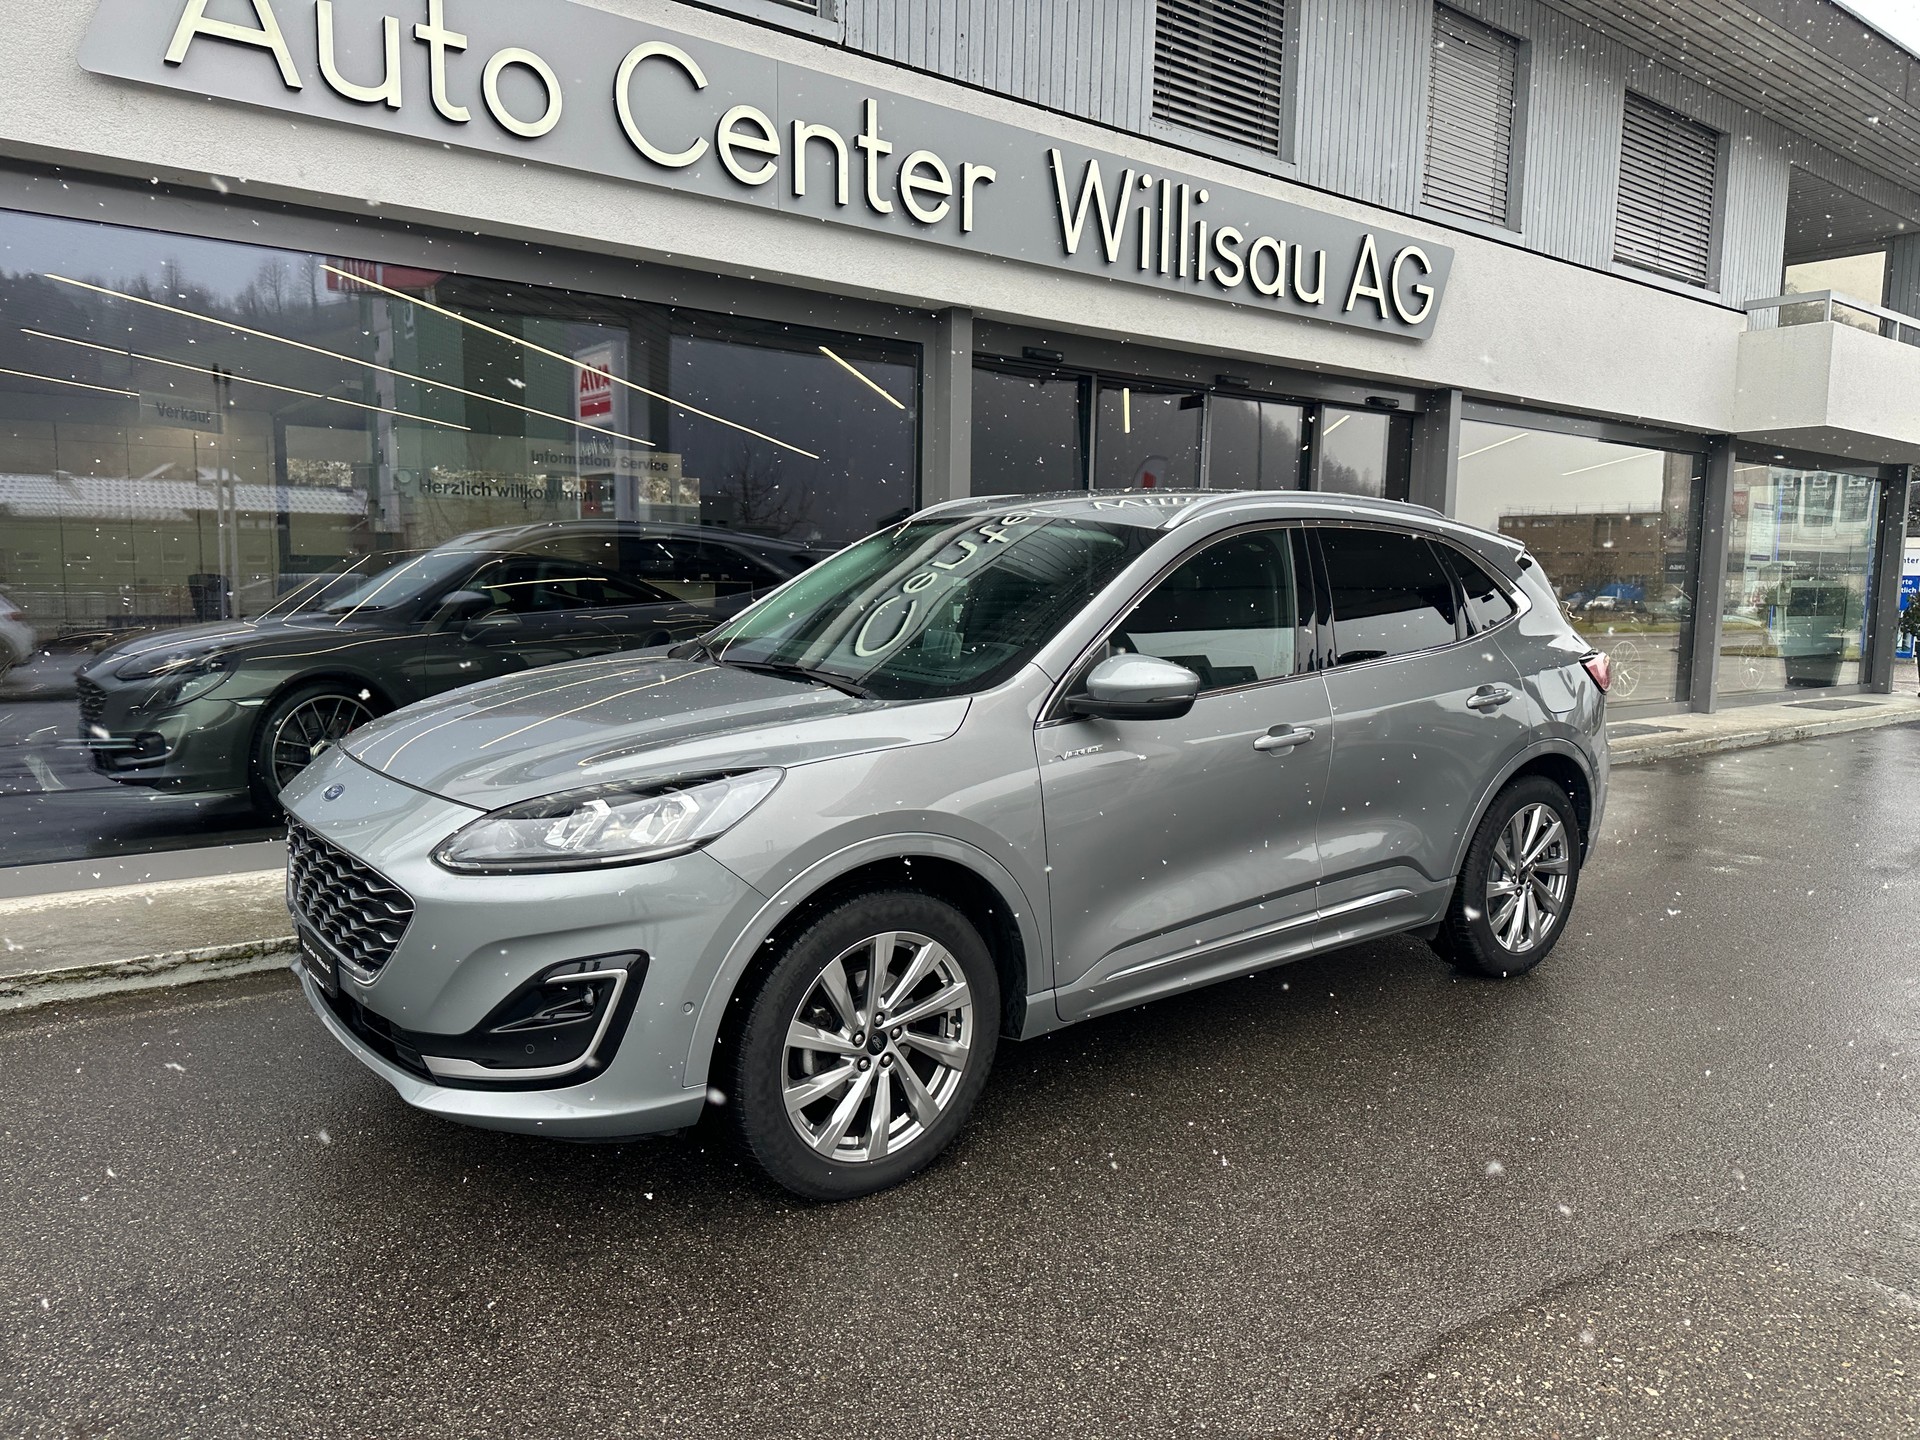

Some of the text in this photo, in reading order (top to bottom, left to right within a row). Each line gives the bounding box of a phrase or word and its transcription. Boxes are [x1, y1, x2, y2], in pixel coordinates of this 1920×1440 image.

[164, 0, 1434, 326] Auto Center Willisau AG
[156, 401, 211, 423] Verkauf
[530, 450, 611, 468] Information
[620, 456, 669, 472] Service
[419, 477, 593, 502] Herzlich willkomen
